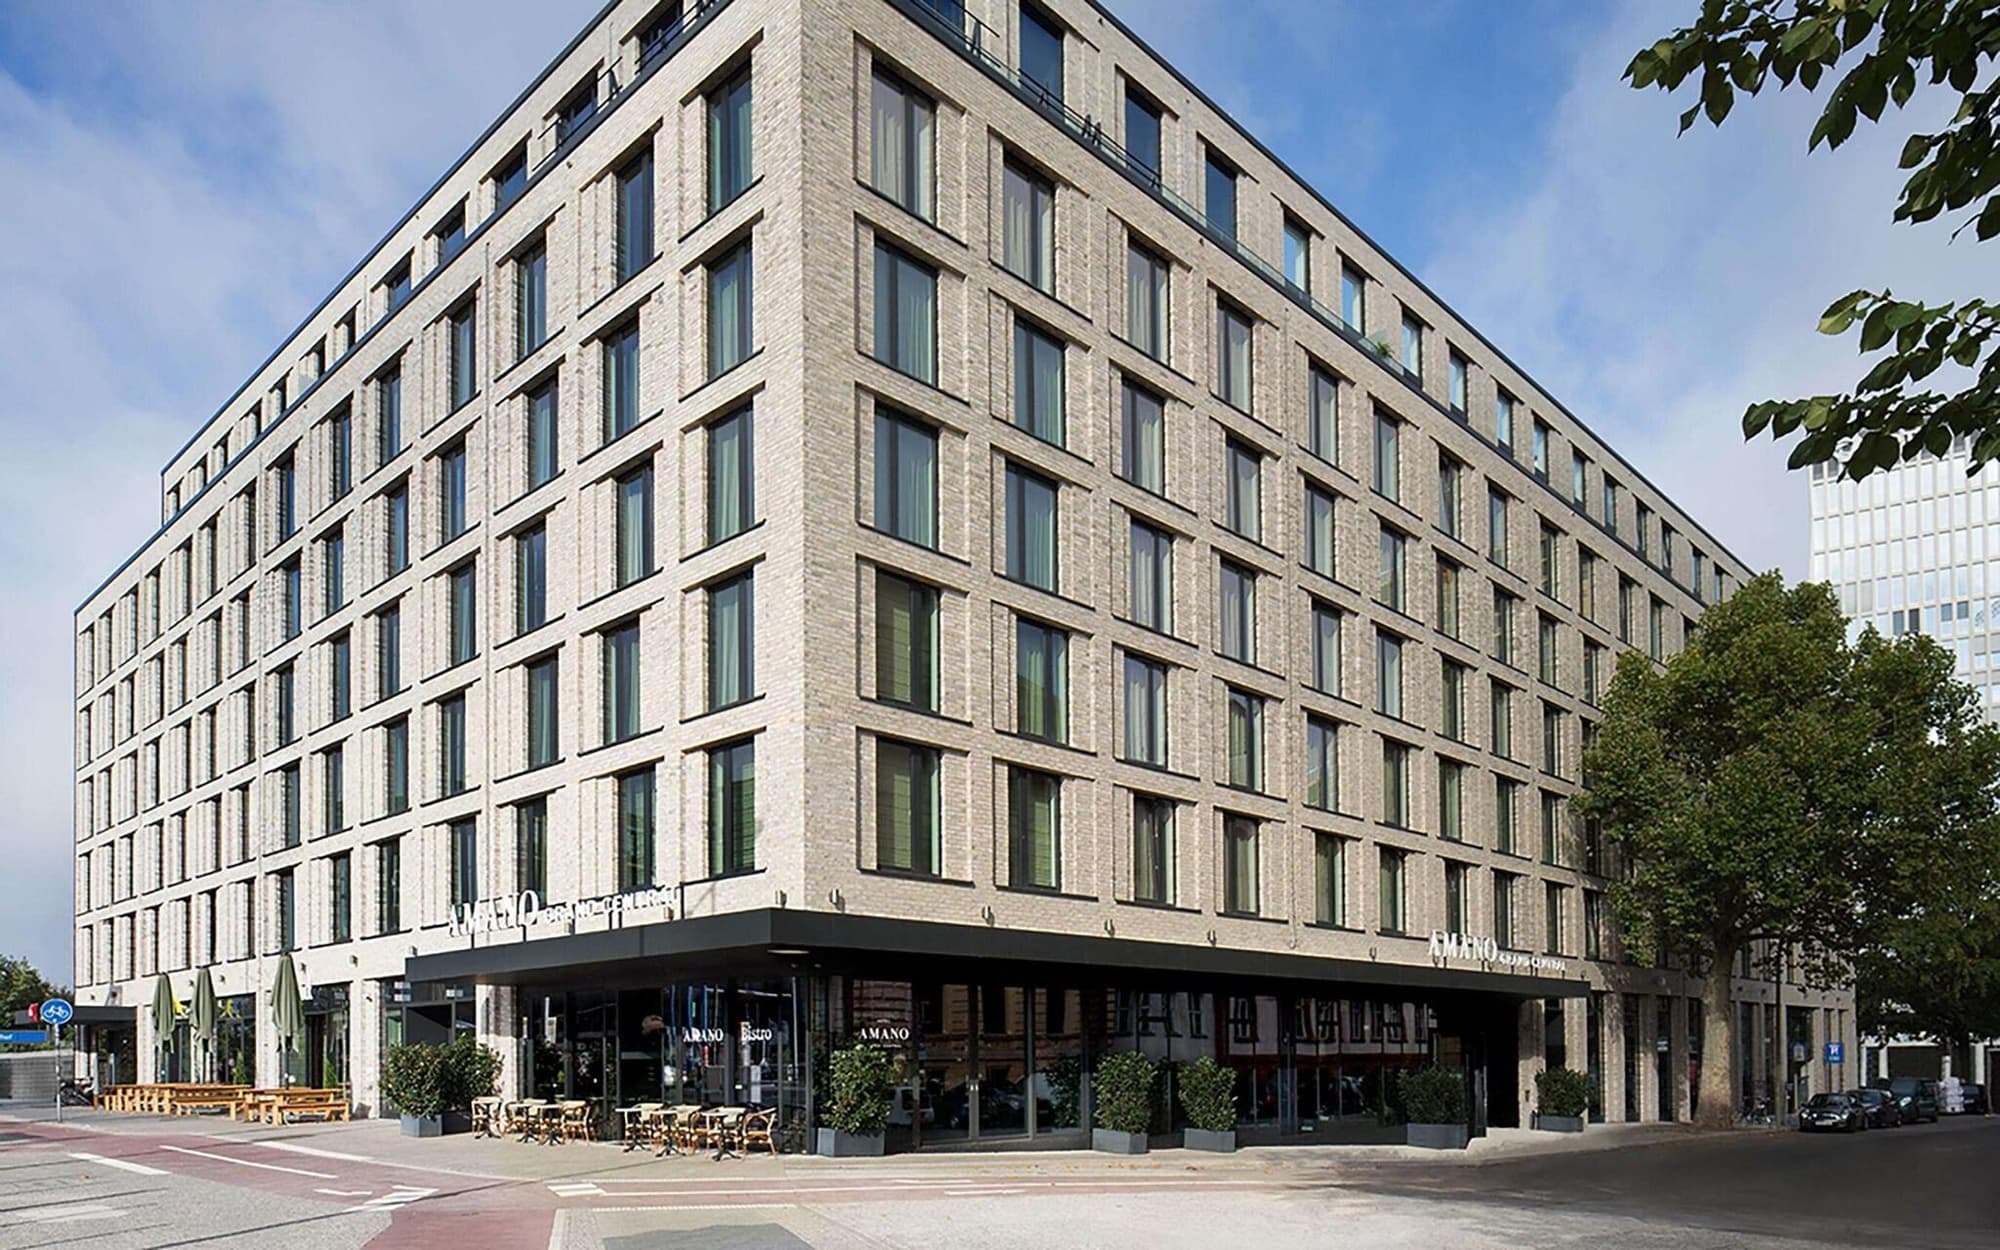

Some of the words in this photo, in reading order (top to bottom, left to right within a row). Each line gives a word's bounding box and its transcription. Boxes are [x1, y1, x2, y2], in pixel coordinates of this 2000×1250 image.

[448, 890, 539, 938] AMANO
[1429, 929, 1498, 962] AMANO
[859, 1027, 910, 1041] AMANO
